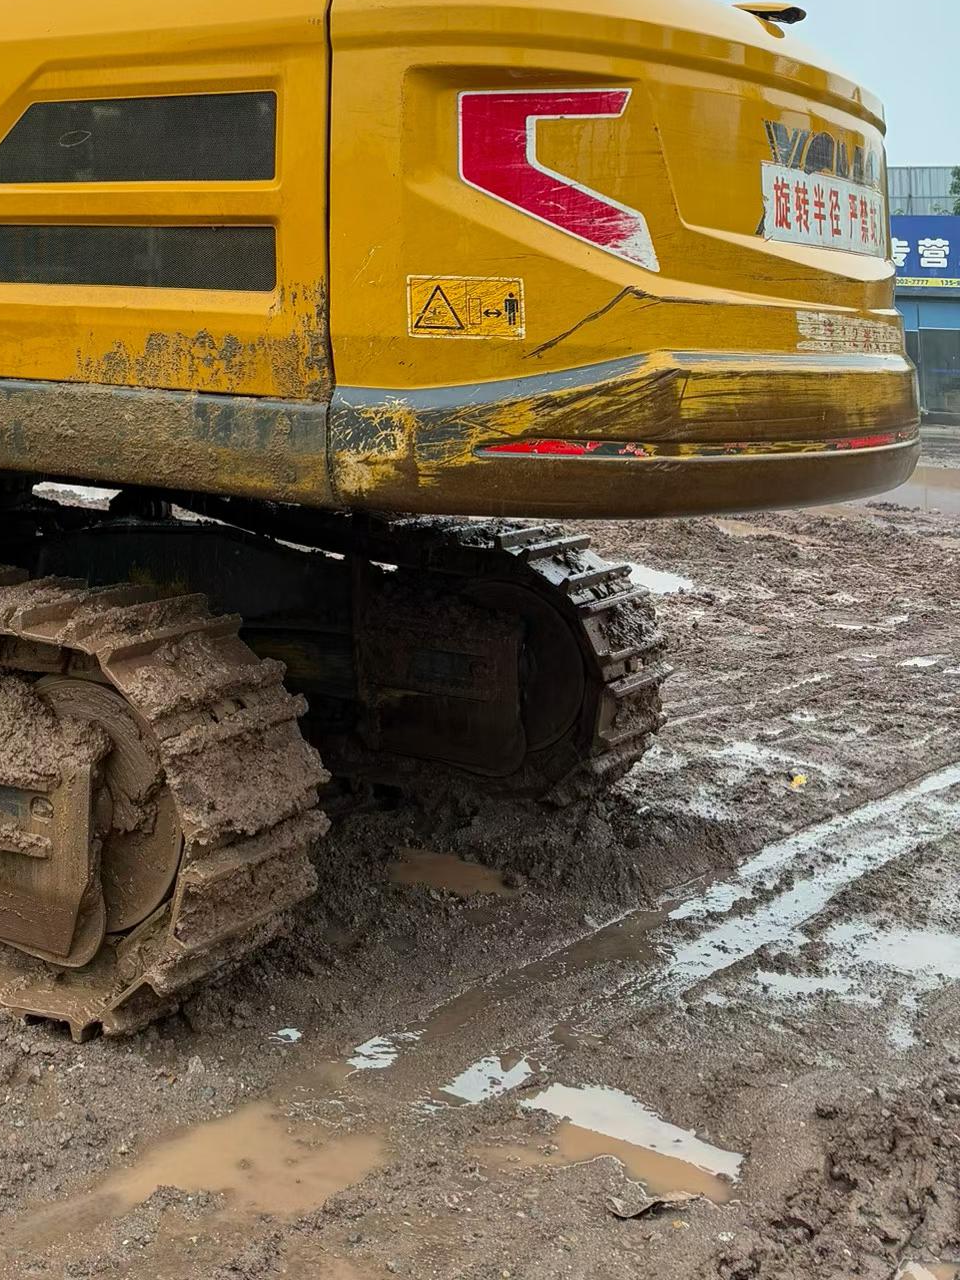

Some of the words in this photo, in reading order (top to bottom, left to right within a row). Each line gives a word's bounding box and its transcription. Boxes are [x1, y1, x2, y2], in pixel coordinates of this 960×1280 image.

[773, 175, 842, 238] 旋转半径
[848, 193, 885, 248] 严禁站人
